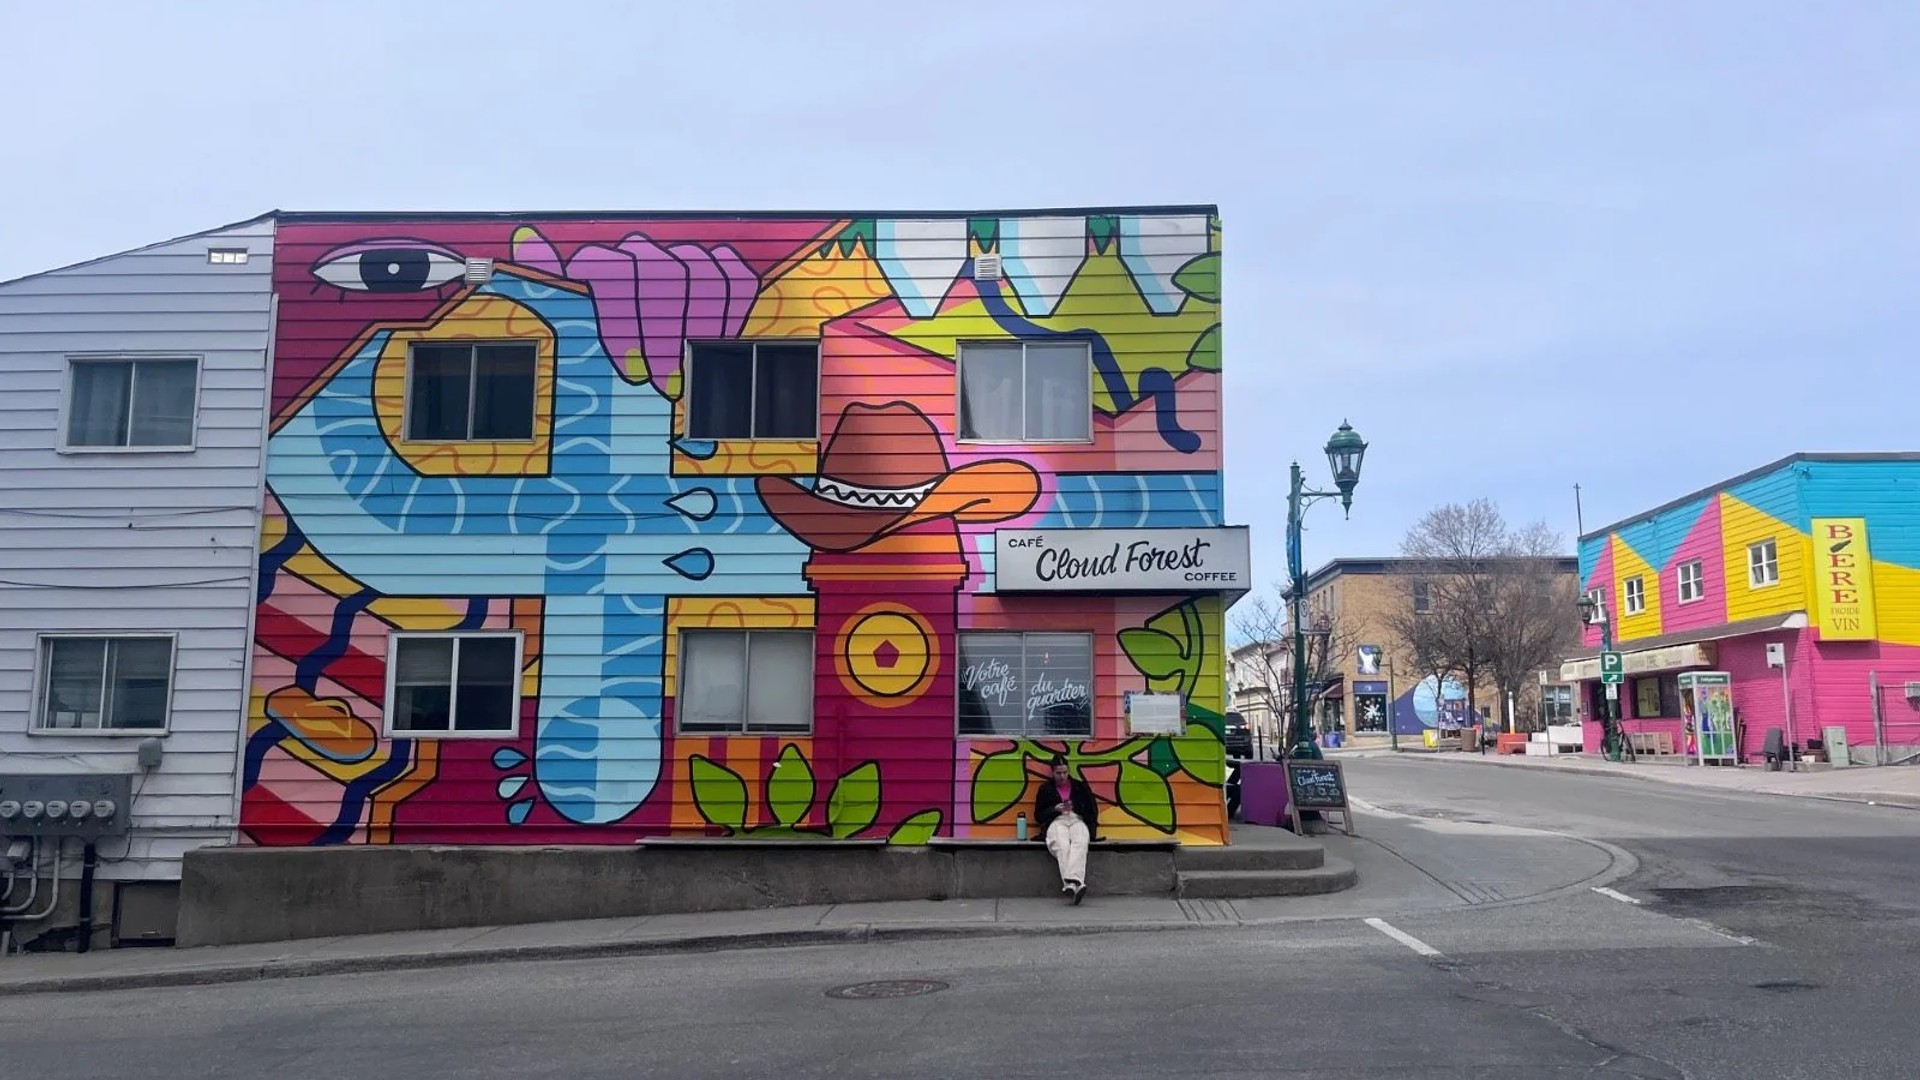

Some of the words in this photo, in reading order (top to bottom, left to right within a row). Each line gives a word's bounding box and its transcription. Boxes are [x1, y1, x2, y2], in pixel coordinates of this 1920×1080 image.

[1008, 536, 1044, 548] CAFÉ
[1036, 543, 1120, 582] Cloud
[1125, 537, 1211, 572] Forest
[1184, 572, 1237, 581] COFFEE
[1832, 618, 1860, 631] VIN
[1604, 654, 1618, 670] P
[965, 658, 1010, 691] Votre
[1030, 672, 1054, 696] du
[980, 675, 1018, 707] café
[1027, 678, 1087, 721] quartier
